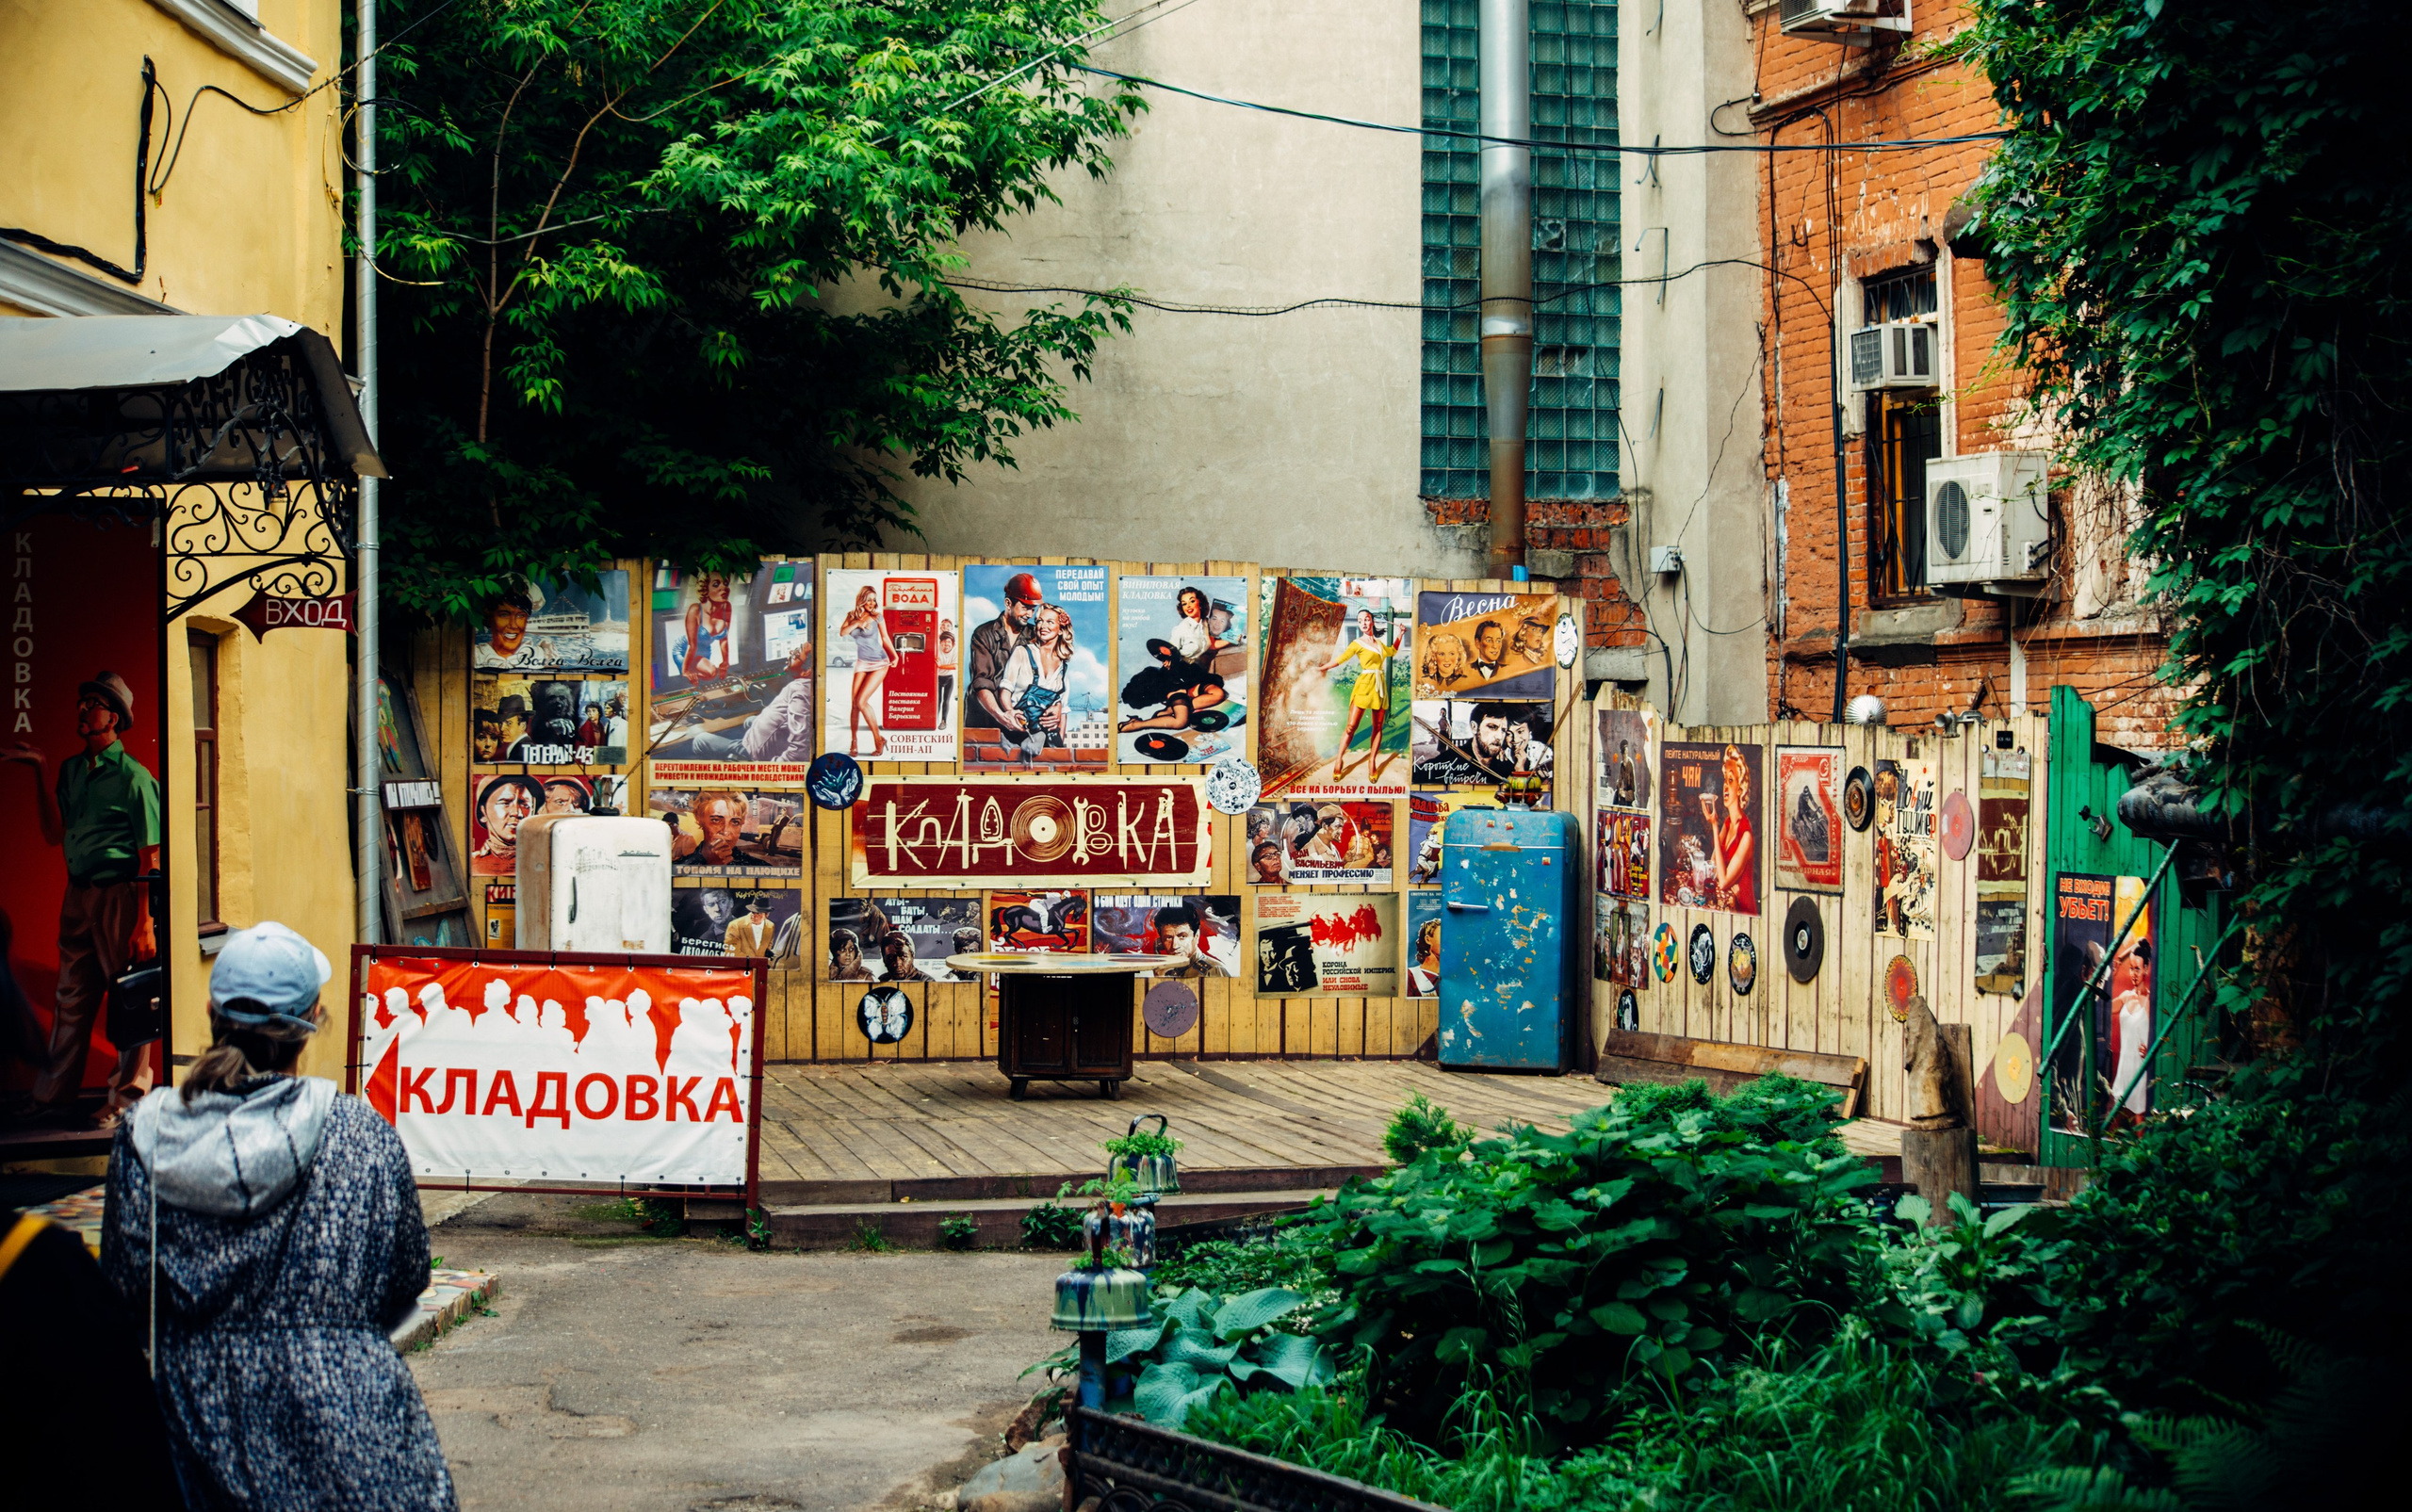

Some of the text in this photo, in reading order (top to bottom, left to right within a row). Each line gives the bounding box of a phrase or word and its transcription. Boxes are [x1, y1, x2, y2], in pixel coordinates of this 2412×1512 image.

[1055, 567, 1104, 579] ПЕРЕДАВАЙ
[1057, 579, 1104, 591] СВОЙ ОПЫТ
[1122, 580, 1182, 590] ВИНИЛОВАЯ
[891, 593, 930, 603] ВОДА
[1059, 592, 1104, 602] МОЛОДЫМ!
[1122, 591, 1173, 600] КЛАДОВКА
[265, 598, 348, 628] ВХОД
[1440, 594, 1520, 627] Весна
[12, 532, 34, 733] КЛАДОВКА
[517, 646, 624, 667] Волга Волга
[888, 713, 921, 722] Барыкина
[890, 734, 953, 743] СОВЕТСКИЙ
[522, 744, 595, 765] ТЕГЕРАН-43
[890, 745, 933, 754] ПИН-АП
[1665, 748, 1720, 761] ПЕЙТЕ НАТУРАЛЬНЫЙ
[655, 763, 711, 772] ПЕРЕУТОМЛЕНИЕ
[723, 764, 755, 772] РАБОЧЕМ
[757, 764, 779, 772] МЕСТЕ
[781, 764, 806, 772] МОЖЕТ
[1413, 755, 1470, 780] Короткие
[751, 773, 805, 782] ПОСЛЕДСТВИЯМ
[1435, 769, 1488, 785] встречи
[1682, 763, 1702, 788] ЧАЙ
[1290, 785, 1406, 794] ВСЕ НА БОРЬБУ С ПЫЛЬЮ!
[1896, 769, 1935, 812] Новый
[1896, 809, 1937, 838] Гулливер
[885, 788, 1178, 871] КЛАДОВКА
[1289, 849, 1310, 860] ИВАН
[676, 866, 800, 876] ТОПОЛЯ НА ПЛЮЩИХЕ
[1288, 870, 1319, 879] МЕНЯЕТ
[1322, 869, 1375, 878] ПРОФЕССИЮ
[2060, 877, 2110, 898] НЕ ВХОДИ!
[885, 898, 910, 906] АТЫ-
[1133, 895, 1151, 908] ОДНИ
[1152, 895, 1183, 908] СТАРИКИ
[900, 906, 929, 916] БАТЫ,
[2059, 895, 2110, 922] УБЬЕТ!
[891, 915, 913, 924] ШЛИ
[898, 924, 952, 935] СОЛДАТЫ...
[1322, 967, 1361, 975] РОССИЙСКОЙ
[1322, 984, 1369, 992] НЕУЛОВИМЫЕ
[399, 1065, 744, 1130] КЛАДОВКА
